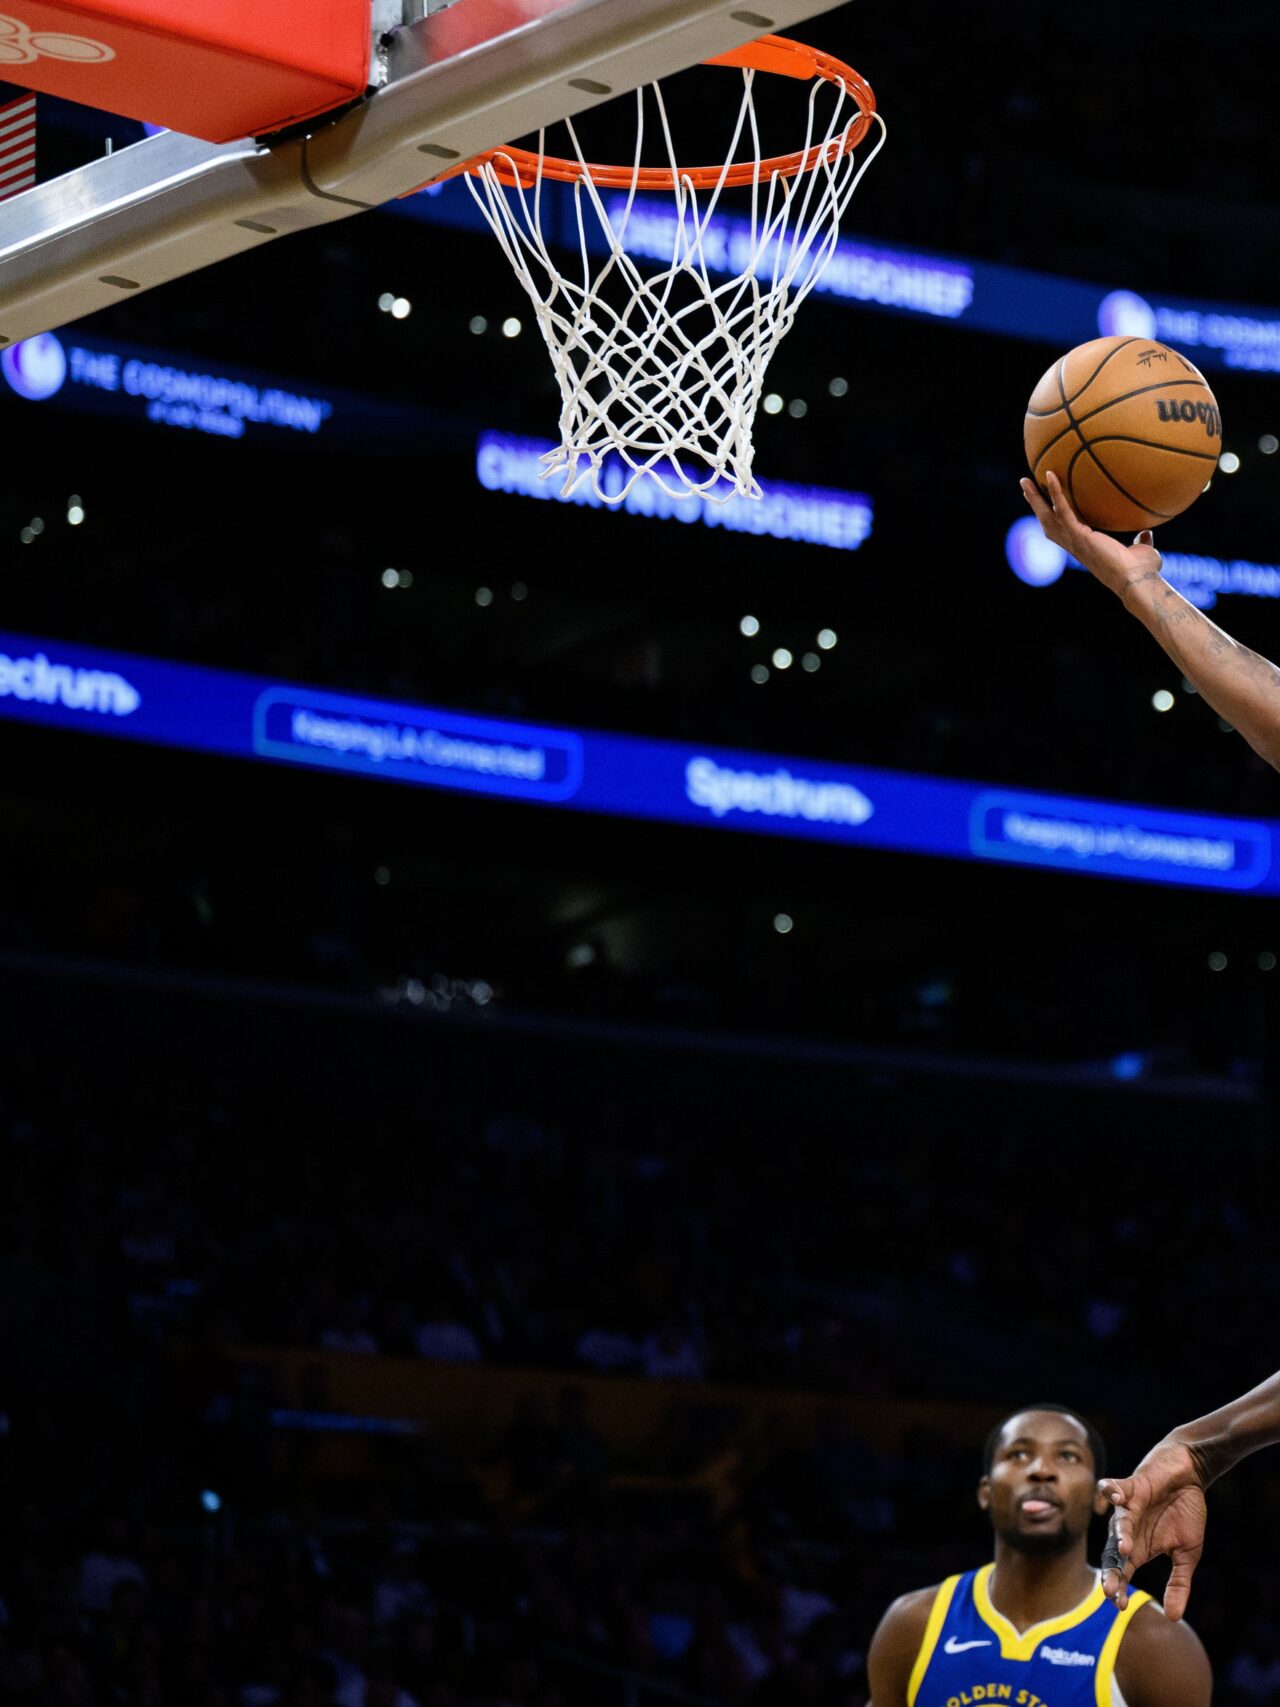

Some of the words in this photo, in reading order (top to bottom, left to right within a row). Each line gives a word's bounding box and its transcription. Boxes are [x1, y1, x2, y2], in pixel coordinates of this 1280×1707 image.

[69, 346, 121, 391] THE
[123, 358, 322, 434] COSMOPOLITAN
[685, 756, 860, 826] Spectrum
[1040, 1645, 1095, 1667] Rakuten
[945, 1683, 1012, 1707] OLDEN
